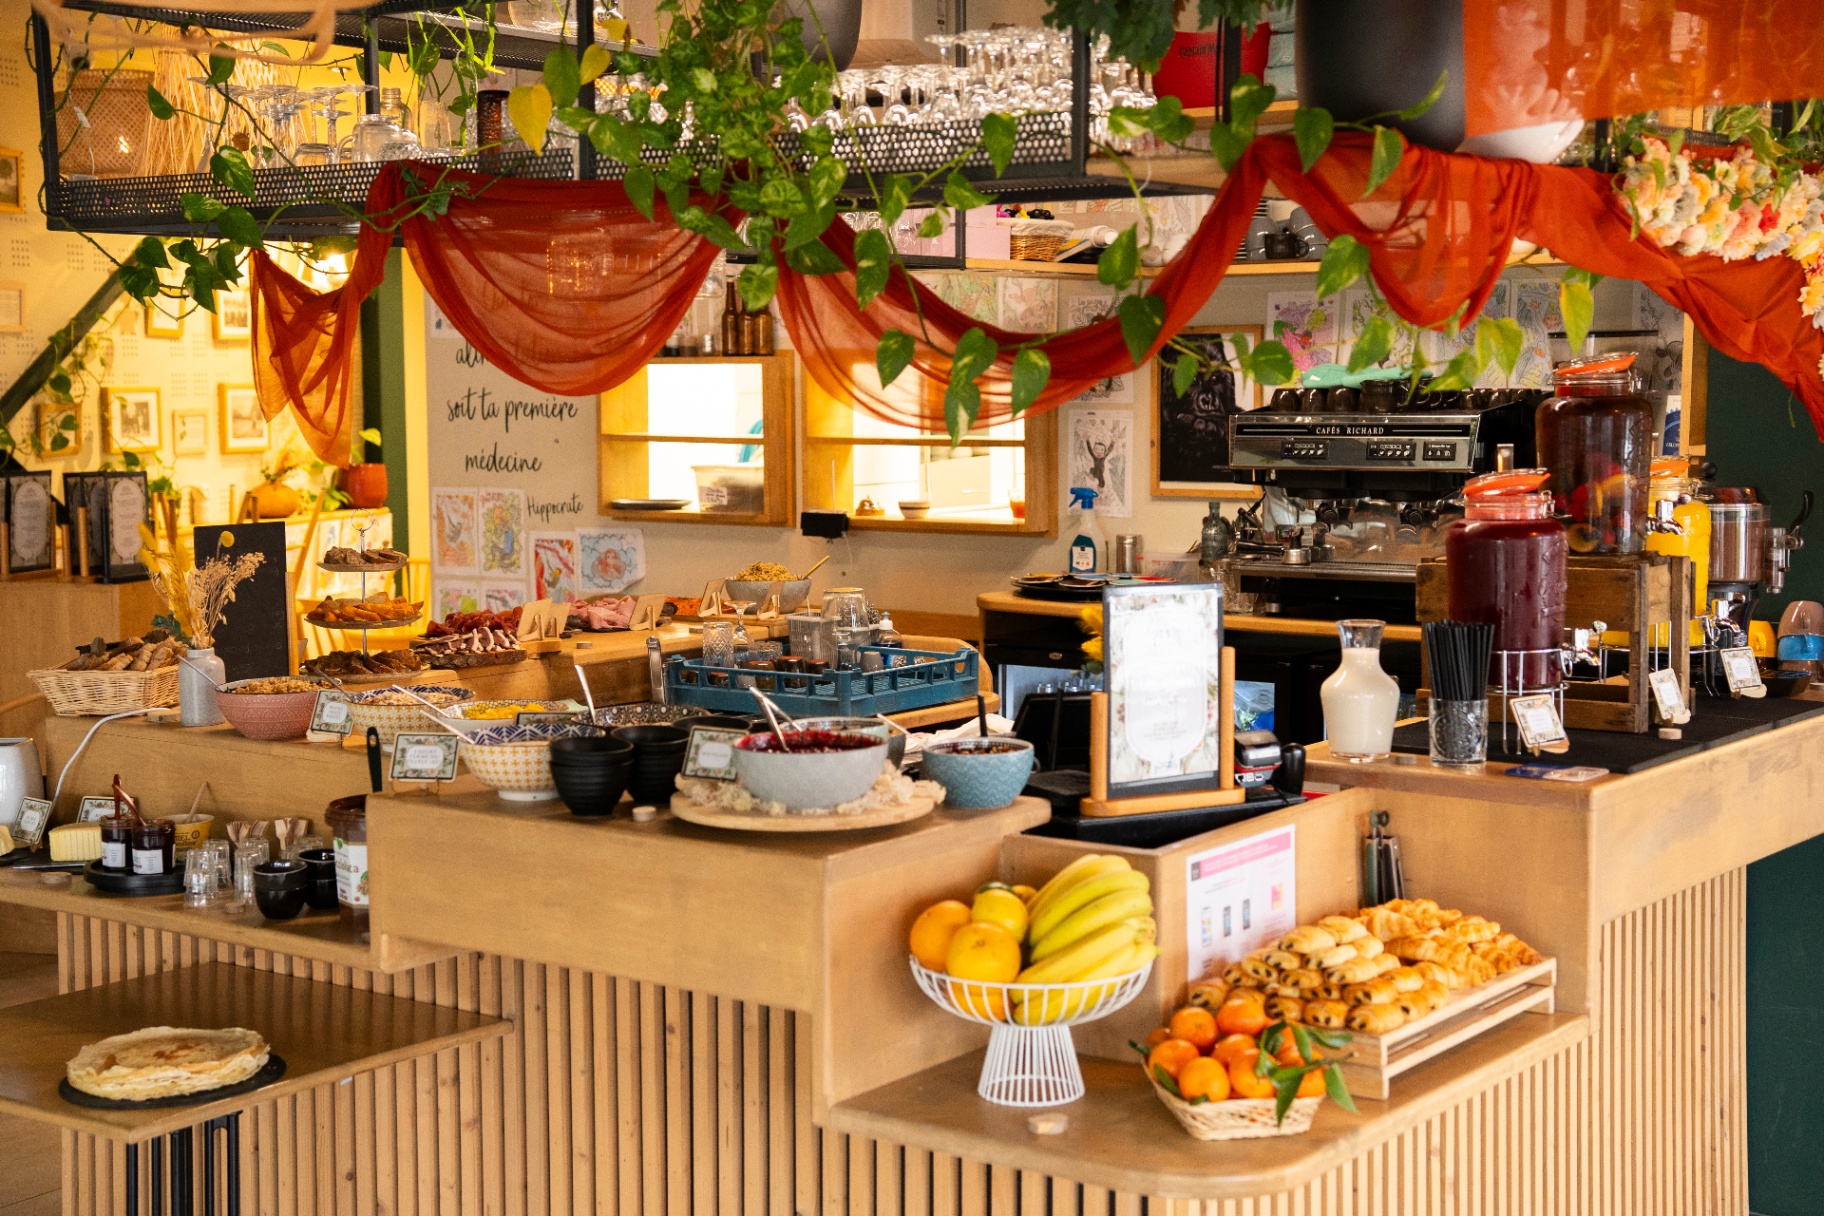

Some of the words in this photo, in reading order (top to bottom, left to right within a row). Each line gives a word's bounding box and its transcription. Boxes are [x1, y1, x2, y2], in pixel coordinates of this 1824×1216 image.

[447, 386, 477, 421] soit
[478, 386, 499, 419] ta
[505, 397, 578, 433] première
[1316, 425, 1341, 435] CAFÉS
[1346, 426, 1385, 436] RICHARD
[465, 442, 543, 474] médecine
[527, 492, 584, 523] Hippocrate
